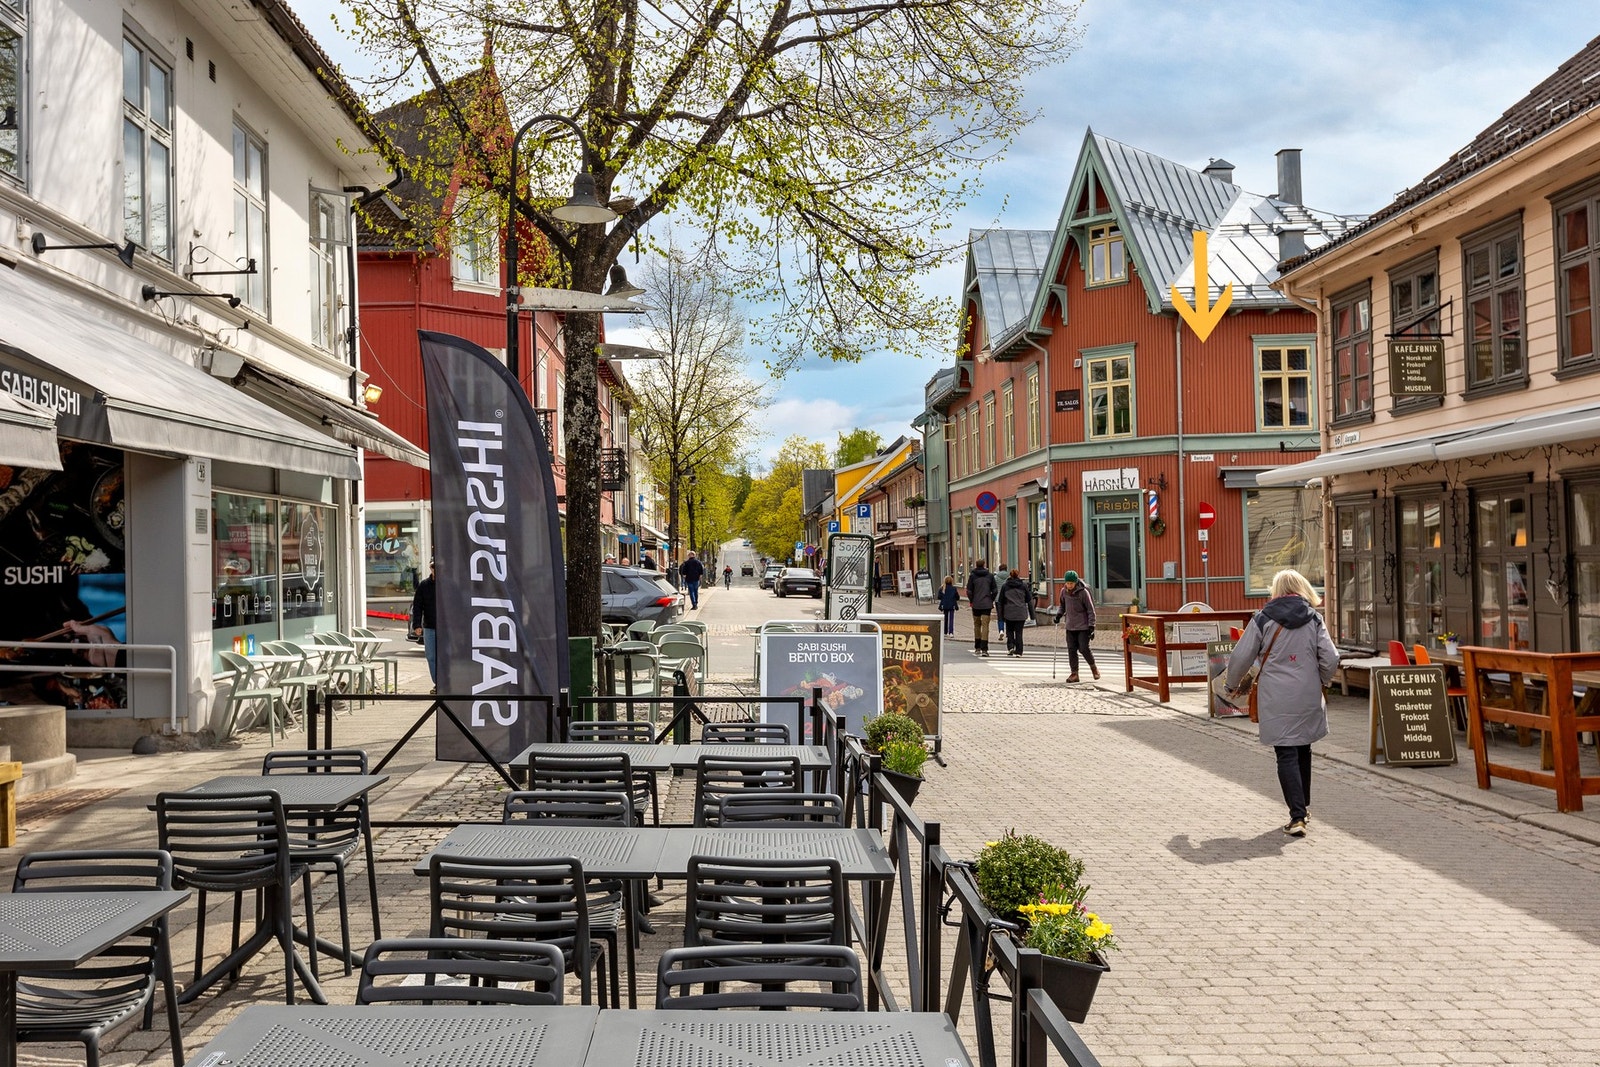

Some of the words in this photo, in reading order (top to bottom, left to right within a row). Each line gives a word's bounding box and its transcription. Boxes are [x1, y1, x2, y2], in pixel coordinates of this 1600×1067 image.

[1395, 344, 1413, 353] KAFÉ
[1415, 345, 1437, 353] FØNIX
[2, 370, 38, 404] SABI
[40, 381, 80, 416] SUSHI
[860, 505, 868, 517] P
[1096, 501, 1139, 511] FRISØR
[830, 522, 837, 531] P
[4, 565, 63, 585] SUSHI
[233, 638, 254, 656] MIX
[797, 642, 819, 652] SABI
[820, 642, 847, 652] SUSHI
[882, 633, 933, 652] EBAB
[1214, 642, 1233, 652] KAFÉ
[788, 652, 828, 663] BENTO
[830, 652, 855, 663] BOX
[882, 649, 893, 659] ULL
[895, 650, 914, 662] ELLER
[916, 652, 933, 663] PITA
[1383, 673, 1406, 684] KAFÉ
[1409, 673, 1437, 684] FØNIX
[1390, 688, 1414, 697] Norsk
[1416, 688, 1432, 696] mat
[1394, 702, 1432, 711] Småretter
[1400, 713, 1430, 721] Frokost
[1406, 723, 1427, 732] Lunsj
[1403, 734, 1432, 743] Middag
[1400, 751, 1440, 759] MUSEUM
